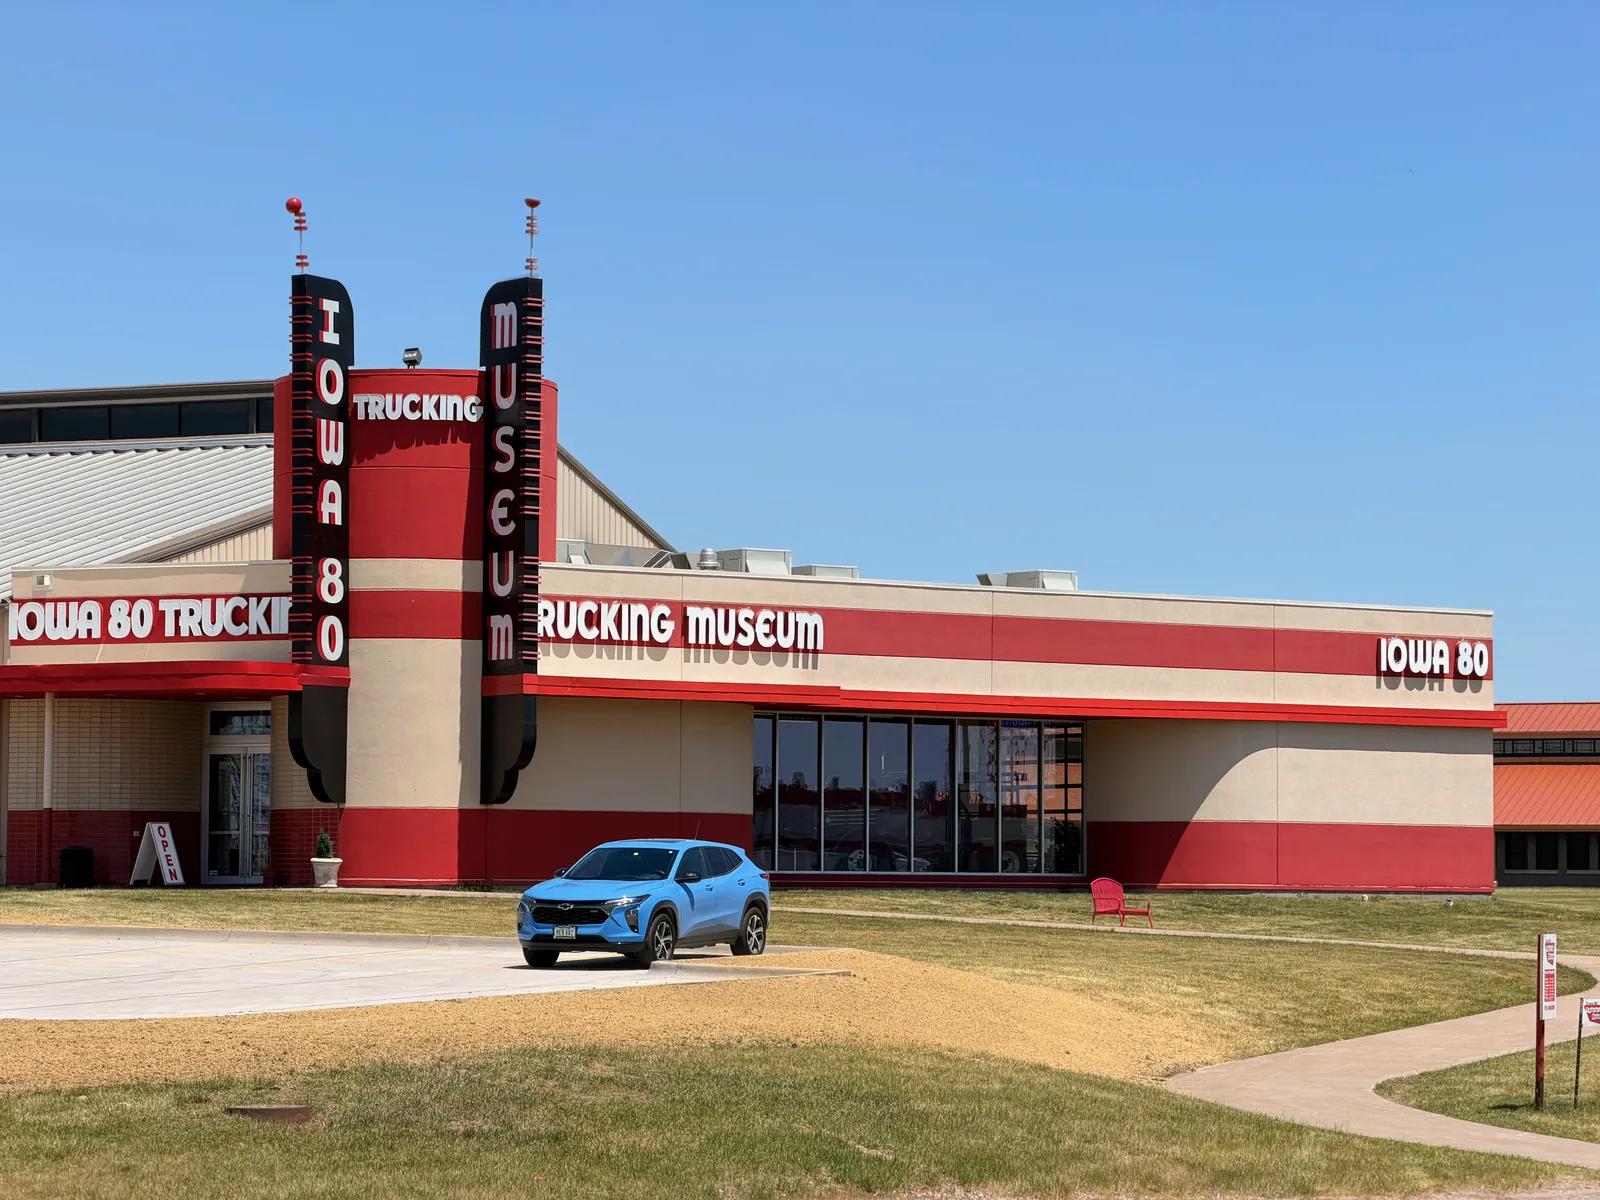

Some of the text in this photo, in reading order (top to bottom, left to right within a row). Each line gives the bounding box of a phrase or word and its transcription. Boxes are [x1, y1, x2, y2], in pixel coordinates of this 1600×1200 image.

[353, 393, 484, 422] TRUCKING
[316, 297, 344, 662] IOWA 80
[488, 301, 518, 661] MUSEUM
[9, 597, 293, 641] IOWA 80 TRUCKI
[538, 599, 824, 650] RUCKING MUSEUM
[1380, 638, 1489, 677] IOWA 80
[157, 825, 179, 881] OPEN
